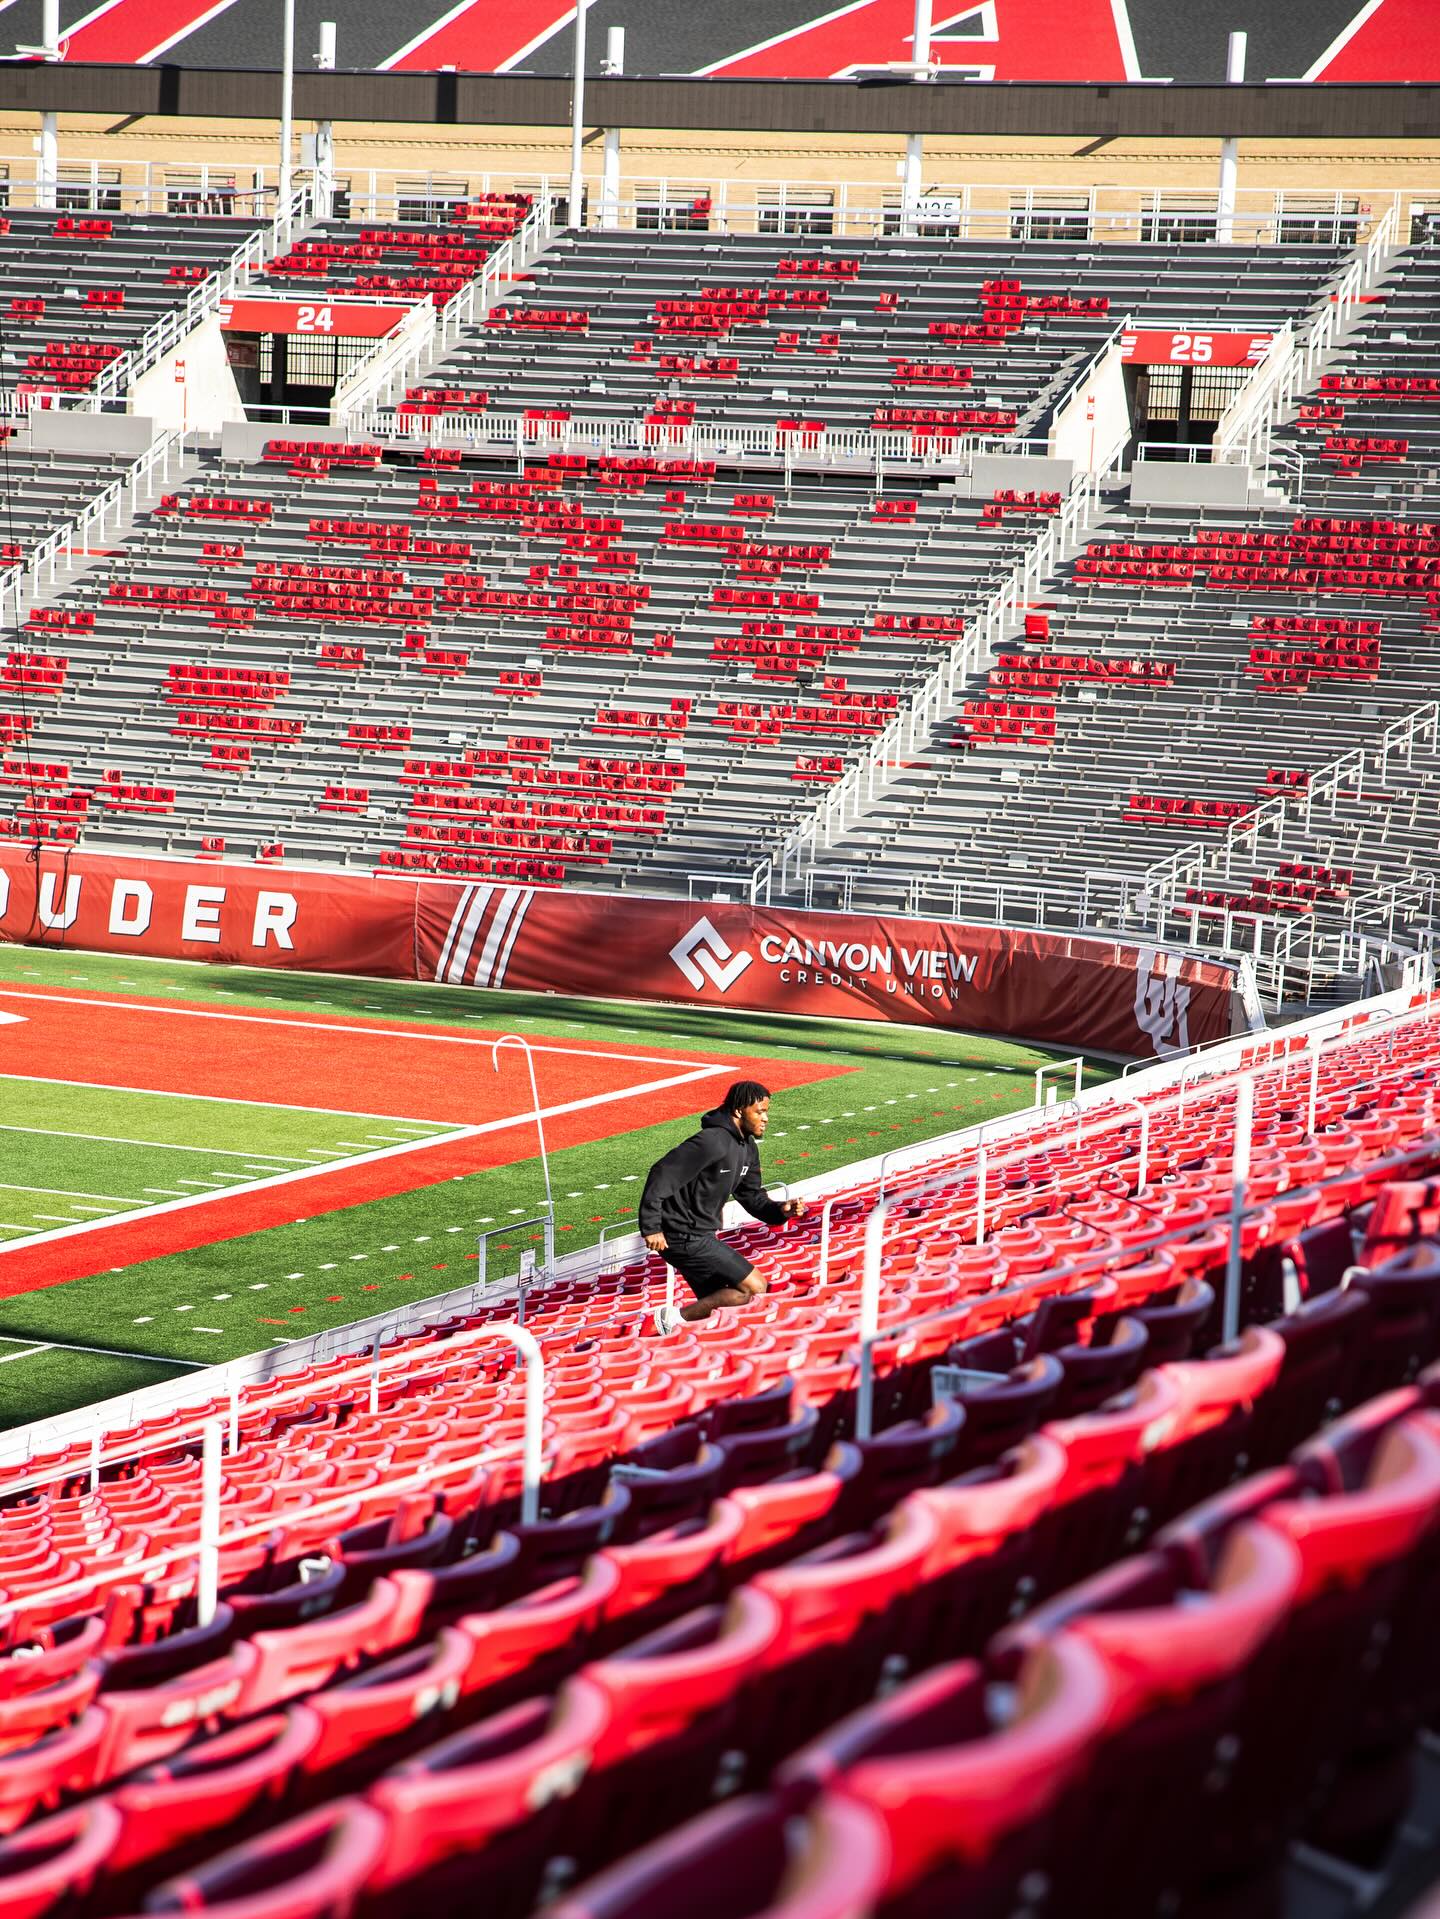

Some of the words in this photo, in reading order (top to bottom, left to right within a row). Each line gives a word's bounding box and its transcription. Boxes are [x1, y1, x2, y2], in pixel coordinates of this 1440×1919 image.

[296, 306, 334, 332] 24
[1170, 334, 1213, 362] 25
[0, 867, 299, 950] UDER
[759, 935, 892, 974] CANYON
[900, 947, 978, 983] VIEW
[779, 969, 868, 989] CREDIT
[886, 979, 960, 1000] UNION
